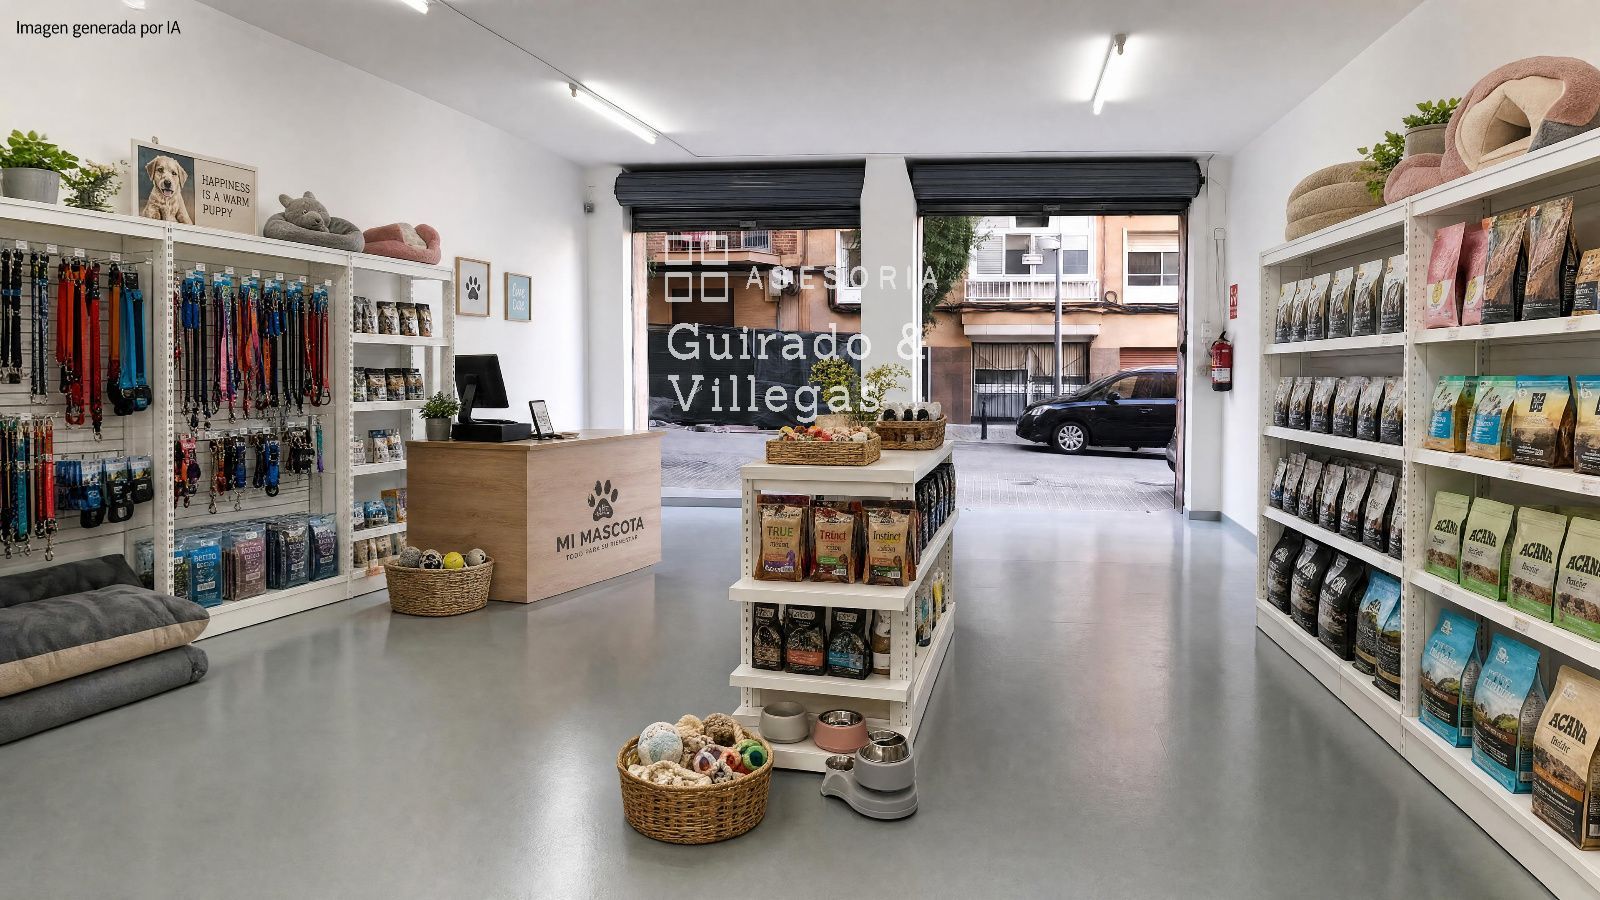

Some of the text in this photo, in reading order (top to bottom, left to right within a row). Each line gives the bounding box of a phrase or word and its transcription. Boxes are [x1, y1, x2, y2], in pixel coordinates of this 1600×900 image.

[202, 174, 251, 194] HAPPINESS
[202, 189, 250, 207] IS A WARM
[202, 203, 233, 218] PUPPY
[556, 516, 645, 553] MI MASCOTA
[766, 526, 794, 538] TRUE
[1468, 528, 1497, 548] ACANA
[1519, 542, 1553, 564] ACANA
[1548, 712, 1588, 746] ACANA
